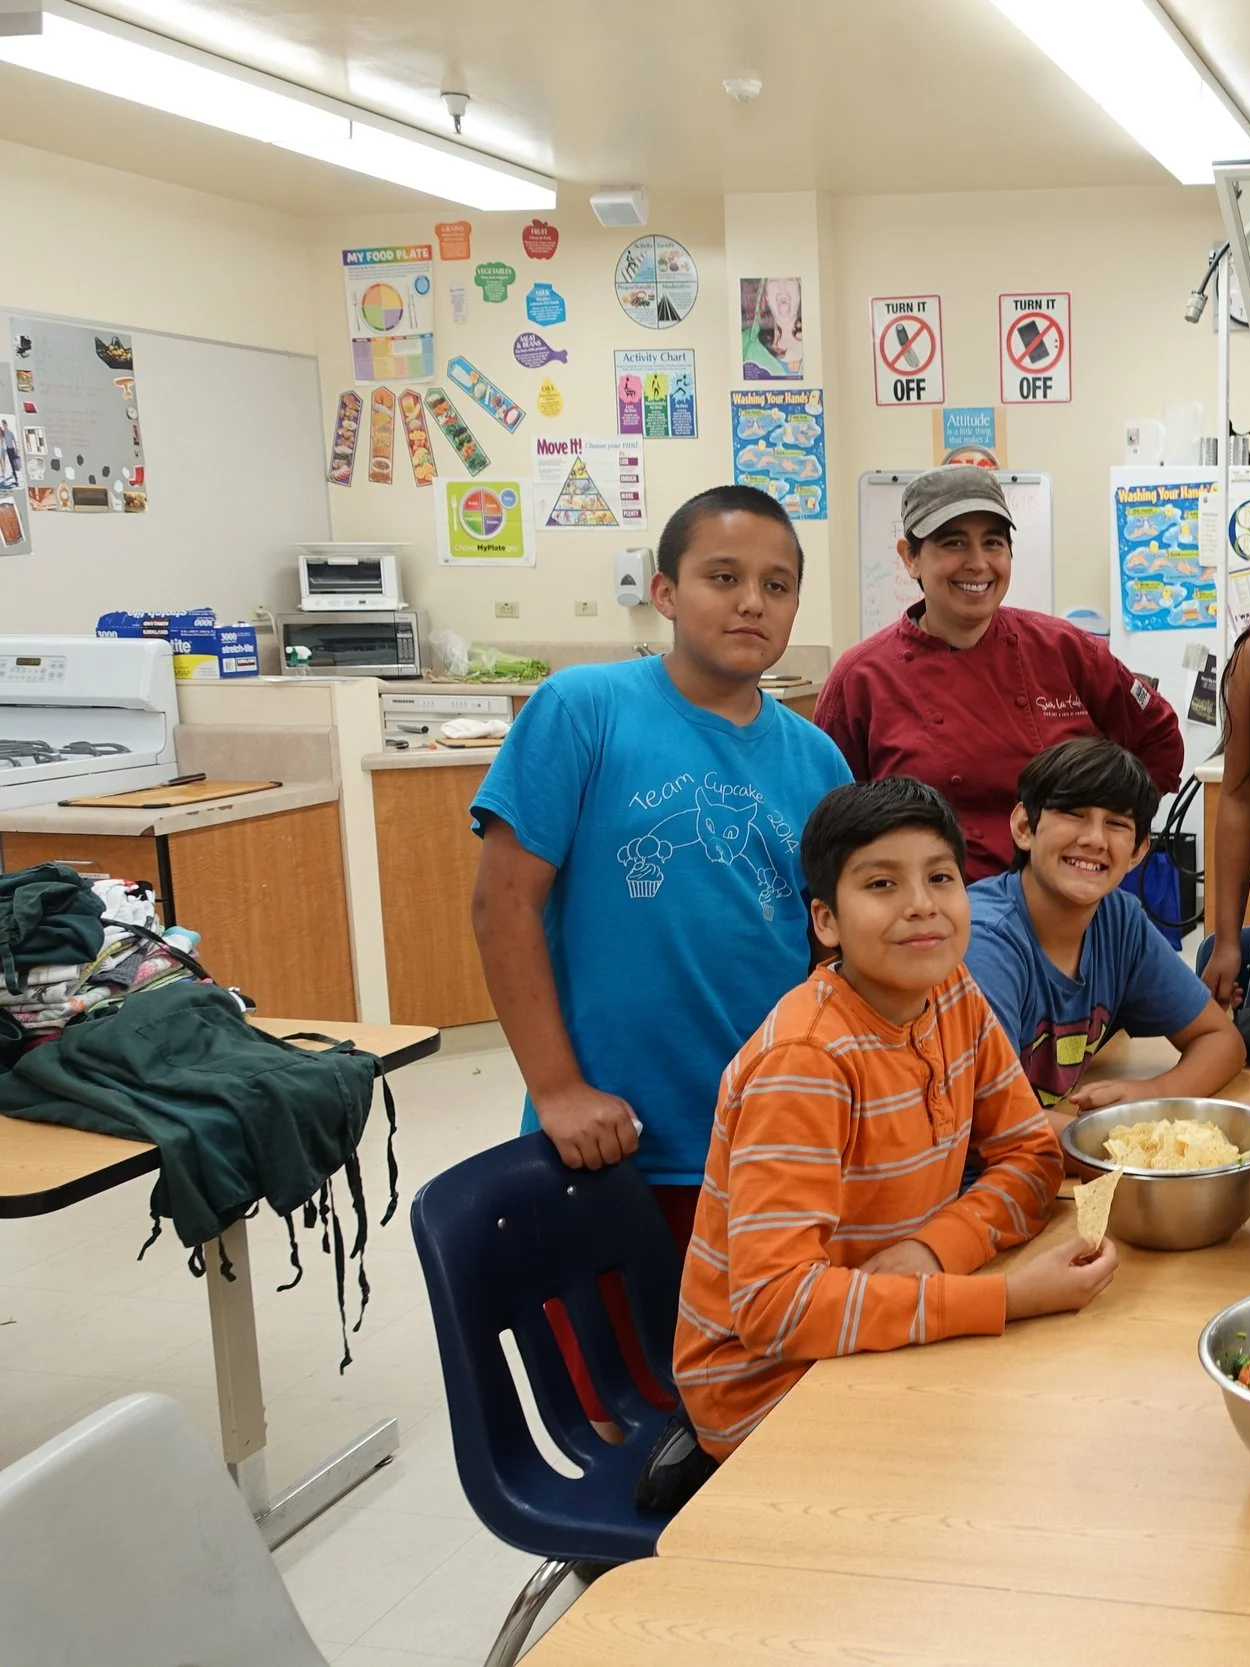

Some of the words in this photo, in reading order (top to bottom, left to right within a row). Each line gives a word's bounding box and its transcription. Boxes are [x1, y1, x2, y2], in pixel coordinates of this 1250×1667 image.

[346, 252, 364, 263] MY
[365, 250, 394, 262] FOOD
[395, 247, 429, 260] PLATE
[477, 267, 512, 276] VEGETABLES
[885, 302, 913, 314] TURN
[917, 301, 927, 312] IT
[1013, 299, 1042, 310] TURN
[1047, 298, 1056, 309] IT
[623, 352, 657, 364] Activity
[660, 352, 687, 362] Chart
[893, 378, 926, 402] OFF
[1019, 376, 1053, 400] OFF
[733, 392, 765, 407] Washing
[765, 393, 784, 404] Your
[785, 391, 808, 404] Hands
[946, 412, 990, 427] Attitude
[947, 427, 953, 435] is
[960, 426, 972, 435] little
[975, 427, 992, 437] thing
[537, 438, 568, 456] Move
[570, 438, 582, 455] It!
[949, 436, 962, 444] that
[963, 436, 983, 444] makes
[1117, 487, 1157, 504] Washing
[1157, 487, 1179, 500] Your
[221, 632, 237, 641] 3000
[222, 644, 254, 654] stretch-tite
[628, 772, 695, 810] Team
[704, 771, 766, 804] Cupcake
[766, 809, 800, 855] 2014
